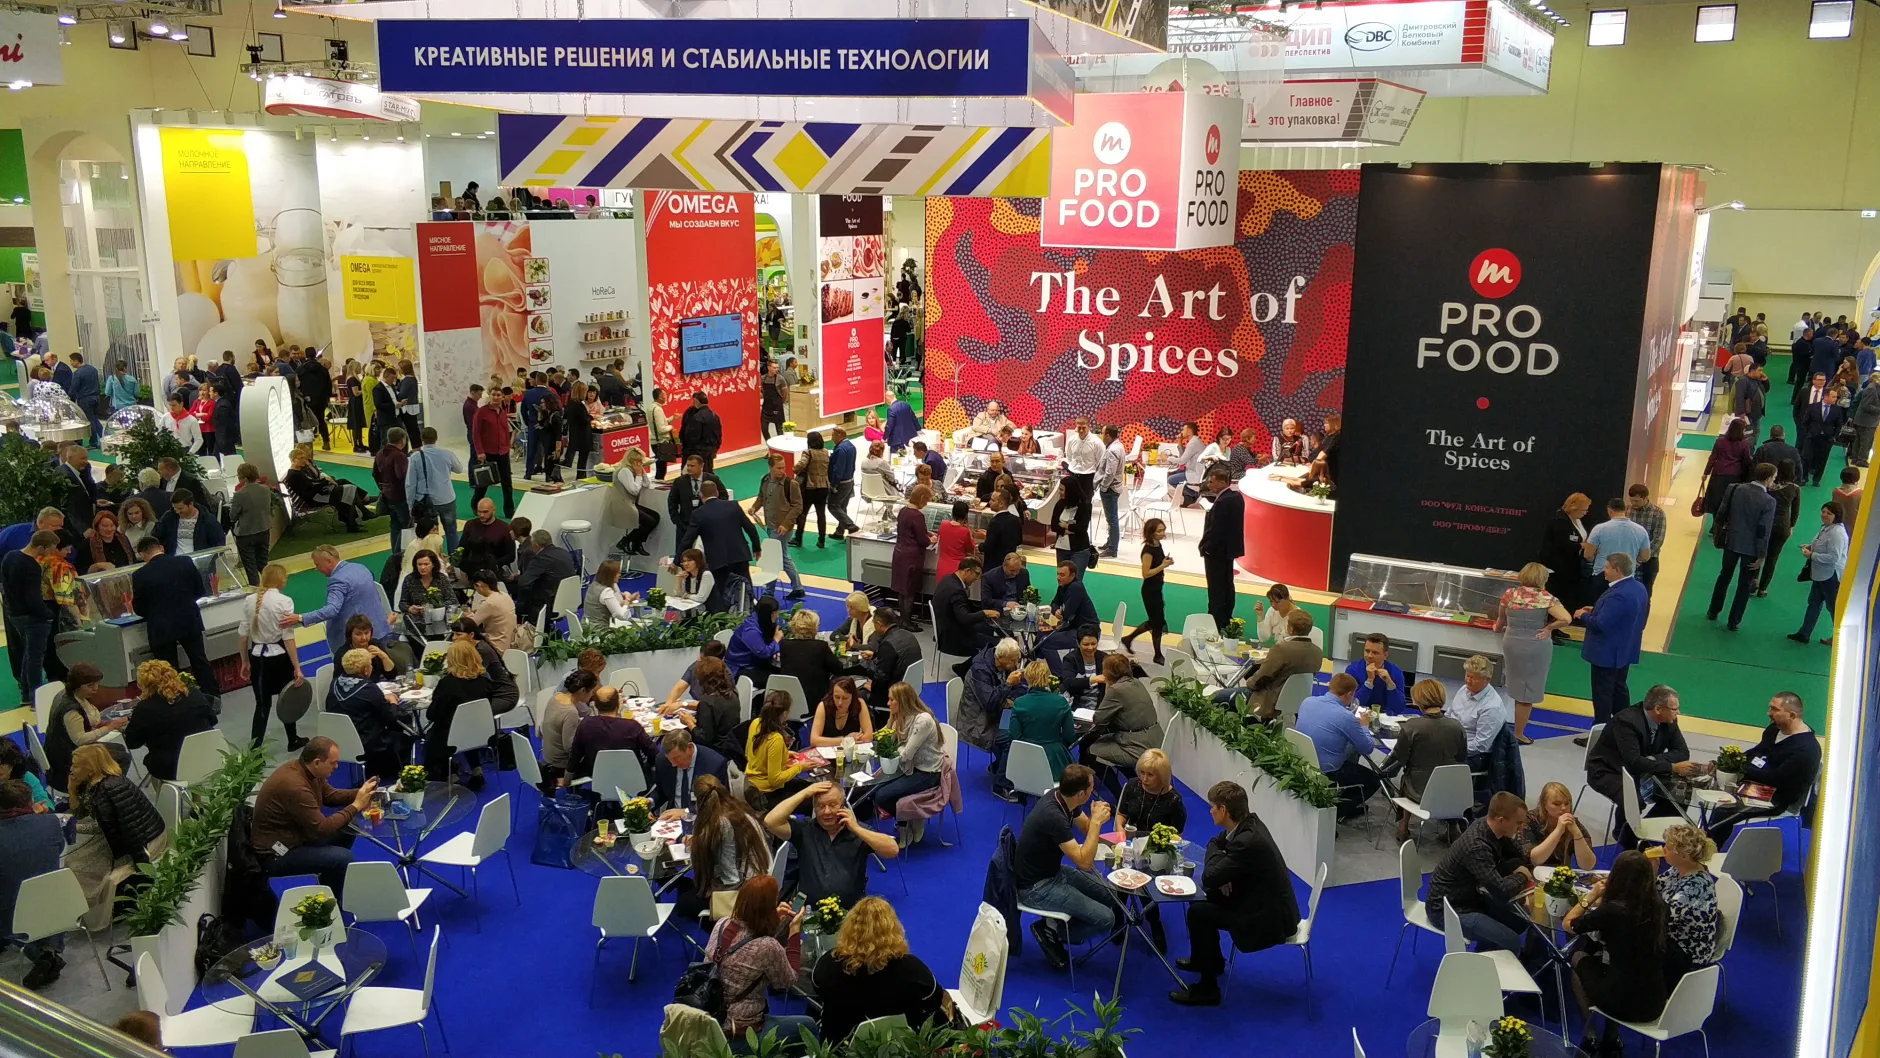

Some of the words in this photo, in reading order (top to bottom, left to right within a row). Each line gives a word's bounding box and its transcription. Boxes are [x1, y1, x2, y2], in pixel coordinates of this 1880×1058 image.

[1402, 22, 1457, 32] Дмитровский
[1365, 30, 1393, 42] DBC
[1402, 31, 1444, 39] Белковый
[1401, 39, 1441, 47] Комбинат
[414, 46, 548, 67] КРЕАТИВНЫЕ
[554, 47, 654, 68] РЕШЕНИЯ
[661, 48, 675, 68] И
[682, 48, 831, 69] СТАБИЛЬНЫЕ
[837, 49, 989, 70] ТЕХНОЛОГИИ
[1289, 95, 1333, 107] Главное
[1268, 116, 1285, 126] это
[1287, 113, 1341, 128] упаковка!
[177, 150, 219, 158] МОЛОЧНОЕ
[178, 160, 232, 169] НАПРАВЛЕНИЕ
[1074, 168, 1147, 198] PRO
[1195, 170, 1225, 197] PRO
[668, 194, 739, 214] OMEGA
[1058, 199, 1160, 228] FOOD
[1186, 200, 1229, 227] FOOD
[669, 220, 683, 229] МЫ
[683, 220, 720, 229] СОЗДАЕМ
[720, 220, 740, 228] ВКУС
[429, 236, 452, 244] МЯСНОЕ
[429, 244, 467, 252] НАПРАВЛЕНИЕ
[350, 262, 371, 273] OMEGA
[592, 286, 616, 296] HoReCa
[1029, 271, 1120, 316] The
[1138, 273, 1227, 321] Art
[1250, 275, 1306, 324] of
[1440, 302, 1542, 338] PRO
[1077, 329, 1239, 381] Spices
[1417, 337, 1559, 376] FOOD
[611, 434, 641, 448] OMEGA
[1425, 429, 1464, 447] The
[1470, 432, 1506, 450] Art
[1512, 436, 1536, 453] of
[1444, 450, 1510, 470] Spices
[1421, 500, 1440, 508] ООО
[1441, 501, 1462, 510] "ФУД
[1465, 503, 1527, 516] КОНСАЛТИНГ"
[1432, 520, 1452, 528] ООО
